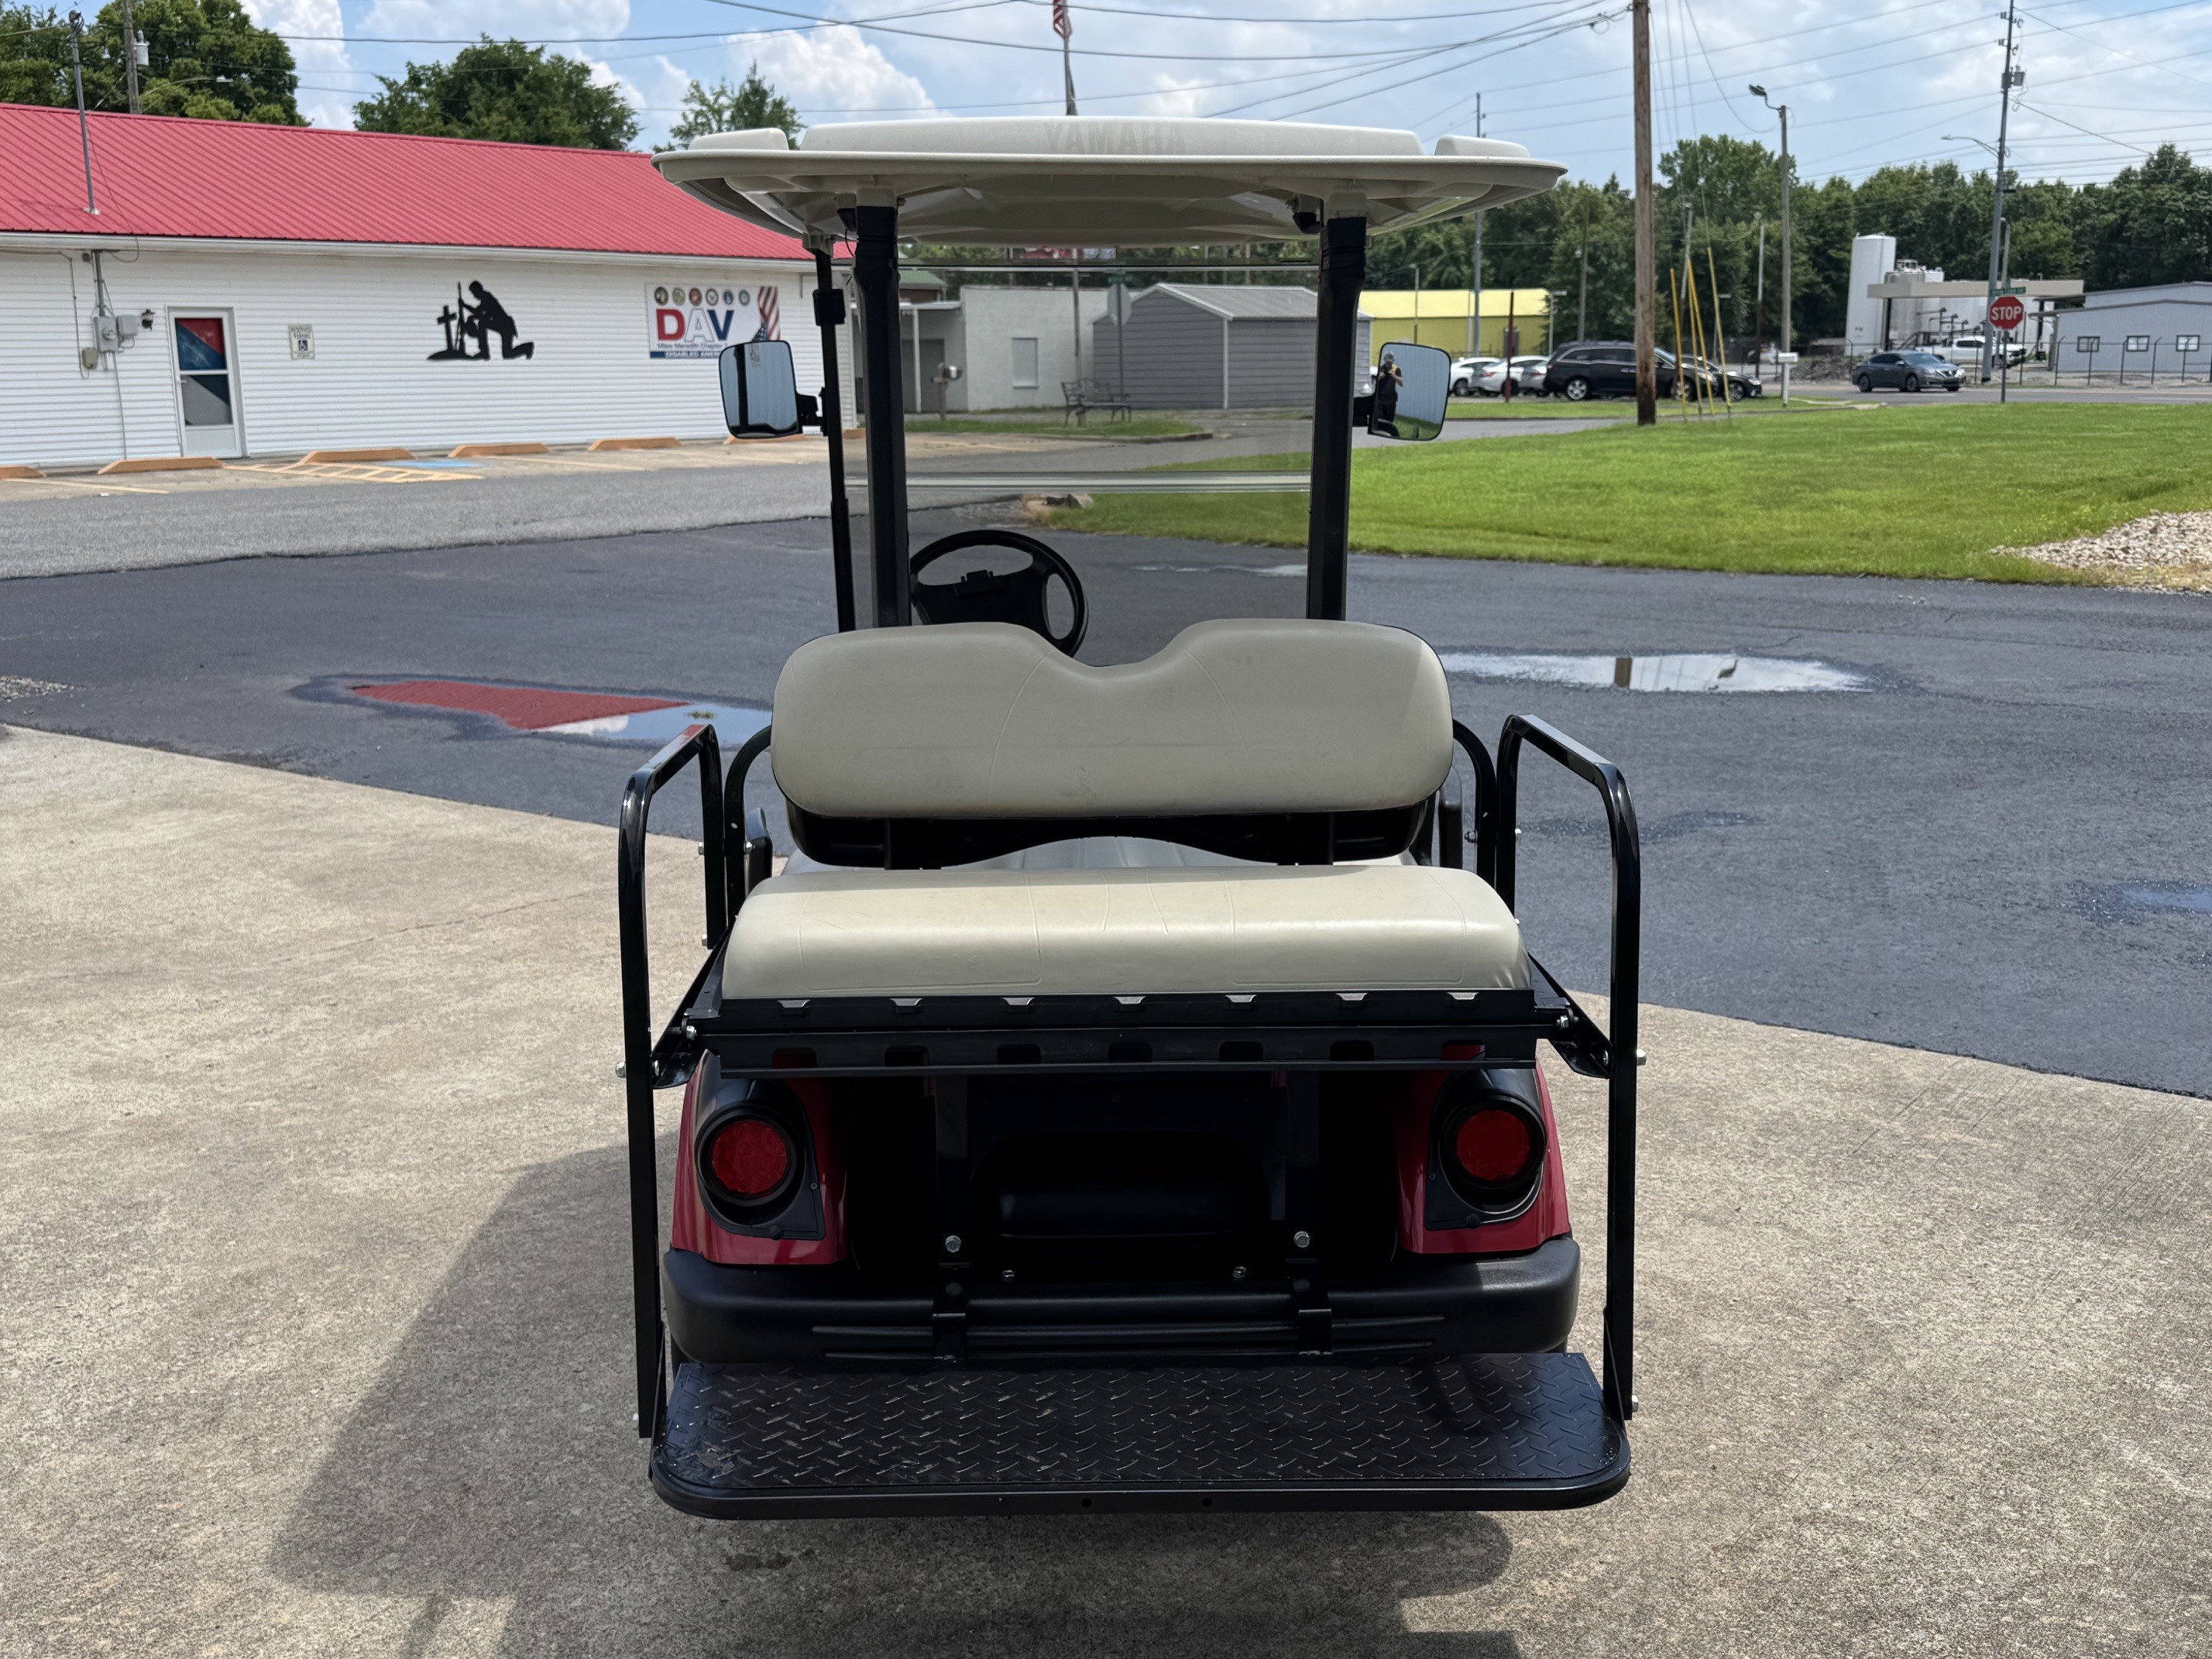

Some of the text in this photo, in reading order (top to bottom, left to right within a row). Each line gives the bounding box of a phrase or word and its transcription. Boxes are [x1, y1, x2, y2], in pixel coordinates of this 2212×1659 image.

[1043, 121, 1186, 154] YAMAHA
[656, 308, 735, 342] DAV
[1991, 306, 2021, 321] STOP
